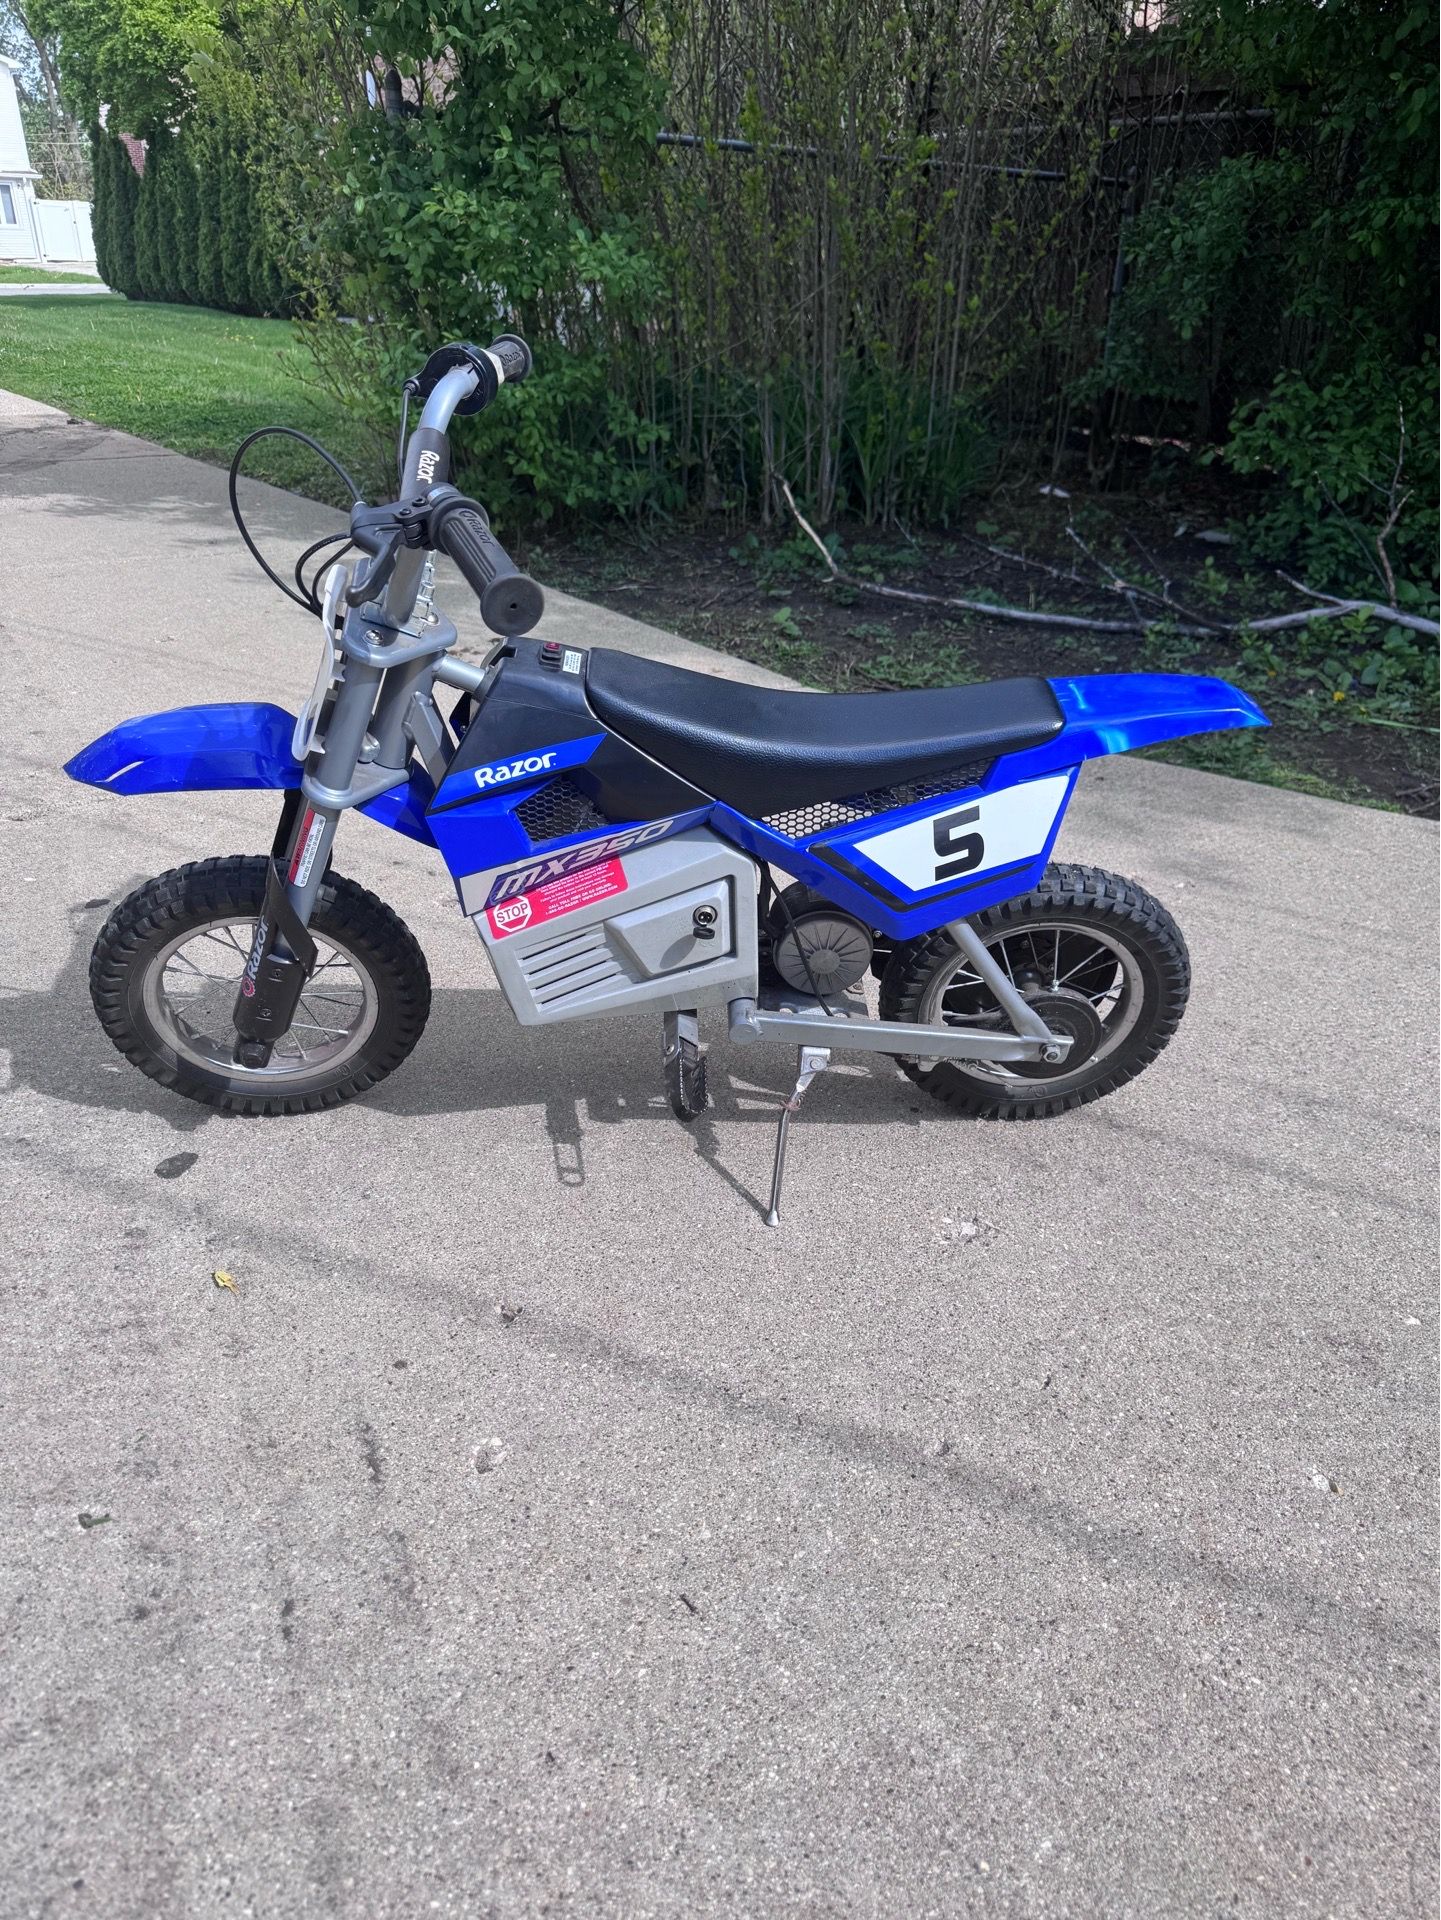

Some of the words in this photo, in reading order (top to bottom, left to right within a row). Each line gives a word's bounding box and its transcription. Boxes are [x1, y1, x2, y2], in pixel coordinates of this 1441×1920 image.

[417, 450, 440, 484] Razor
[474, 752, 557, 788] Razor
[494, 819, 674, 900] MX350
[933, 805, 985, 881] 5
[496, 902, 529, 923] STOP
[247, 915, 269, 980] Razor
